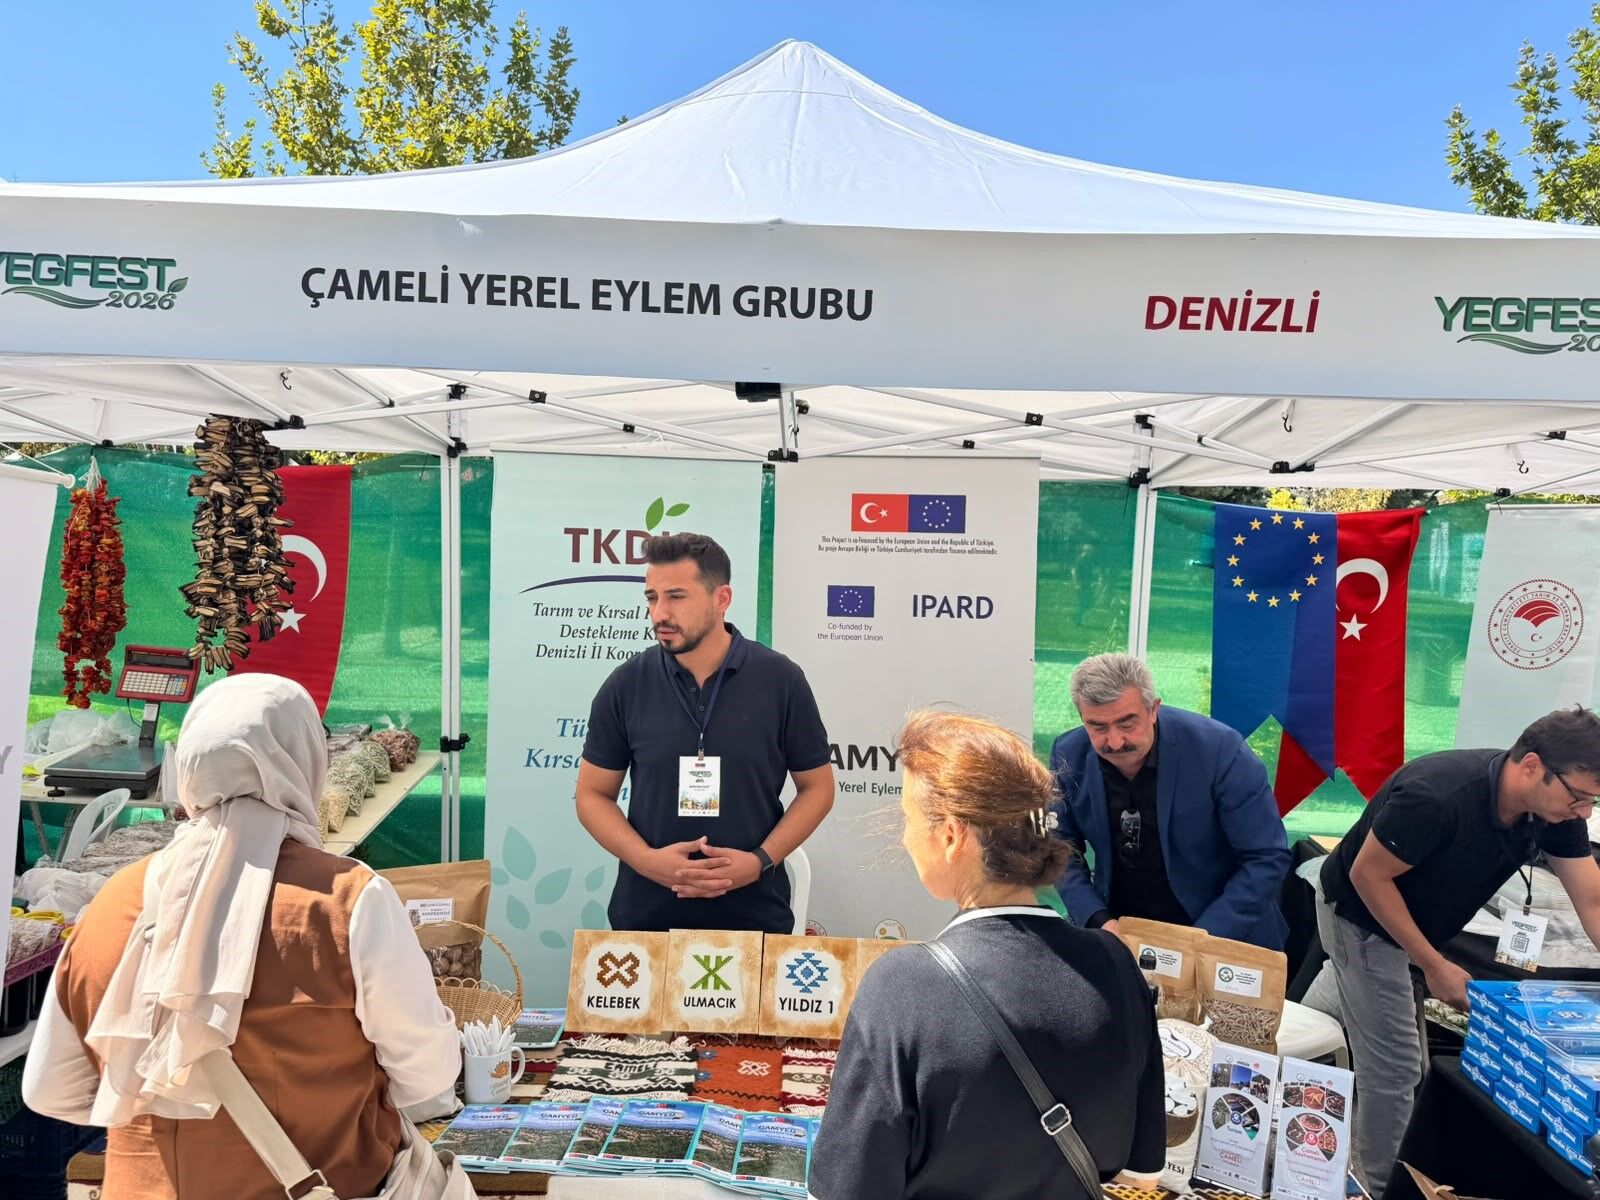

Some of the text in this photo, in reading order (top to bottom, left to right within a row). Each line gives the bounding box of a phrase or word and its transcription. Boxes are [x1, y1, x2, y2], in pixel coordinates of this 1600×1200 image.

[0, 251, 177, 292] EGFEST
[105, 290, 177, 310] 2026
[301, 264, 874, 321] ÇAMELİ YEREL EYLEM GRUBU
[1145, 288, 1321, 333] DENİZLİ
[563, 527, 671, 565] TKD
[831, 536, 847, 544] Project
[879, 537, 885, 545] by
[855, 545, 869, 553] Birliği
[533, 602, 573, 618] Tarım
[578, 607, 594, 618] ve
[597, 604, 641, 620] Kırsal
[912, 594, 994, 620] IPARD
[560, 624, 639, 641] Destekleme
[830, 633, 862, 641] European
[535, 644, 587, 659] Denizli
[590, 642, 602, 660] İl
[839, 781, 867, 793] Yerel
[586, 995, 641, 1010] KELEBEK
[683, 995, 737, 1009] ULMACIK
[779, 997, 834, 1014] YILDIZ 1
